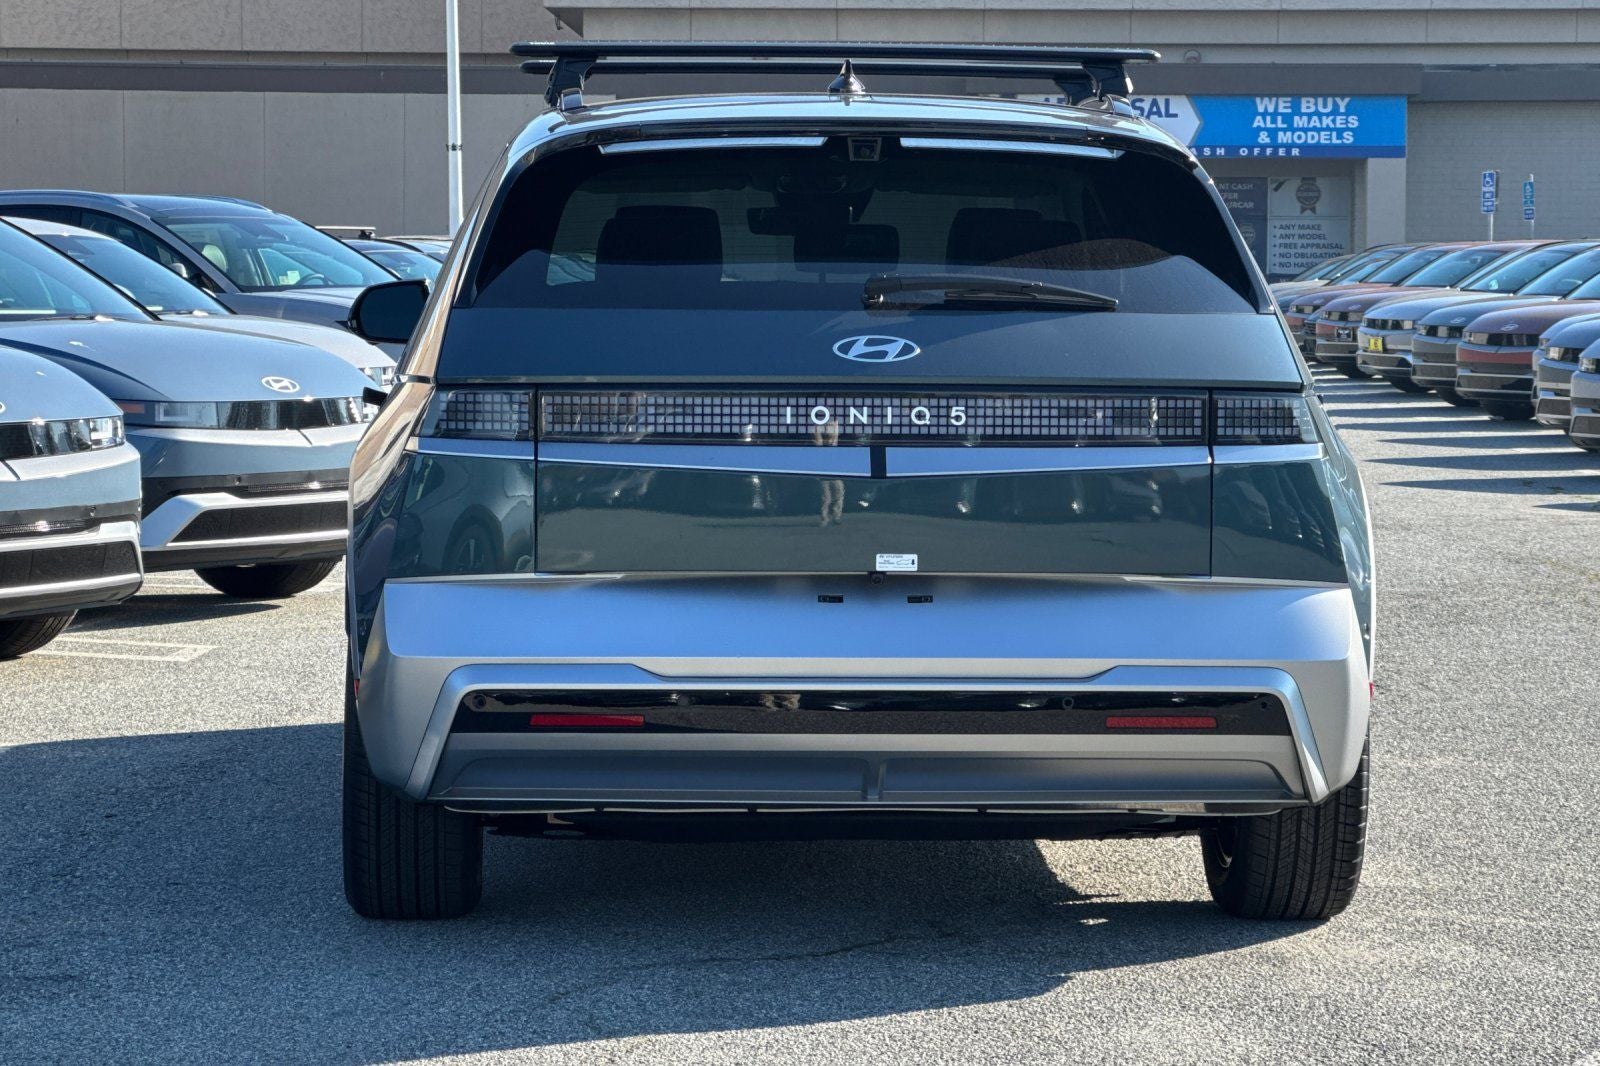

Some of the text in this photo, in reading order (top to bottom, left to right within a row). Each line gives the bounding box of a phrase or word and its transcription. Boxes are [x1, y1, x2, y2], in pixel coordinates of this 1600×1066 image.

[1255, 97, 1351, 113] WE BUY
[1252, 116, 1359, 128] ALL MAKES
[1257, 131, 1354, 143] & MODELS
[1190, 147, 1301, 156] ASH OFFER
[786, 405, 966, 426] IONIQ 5
